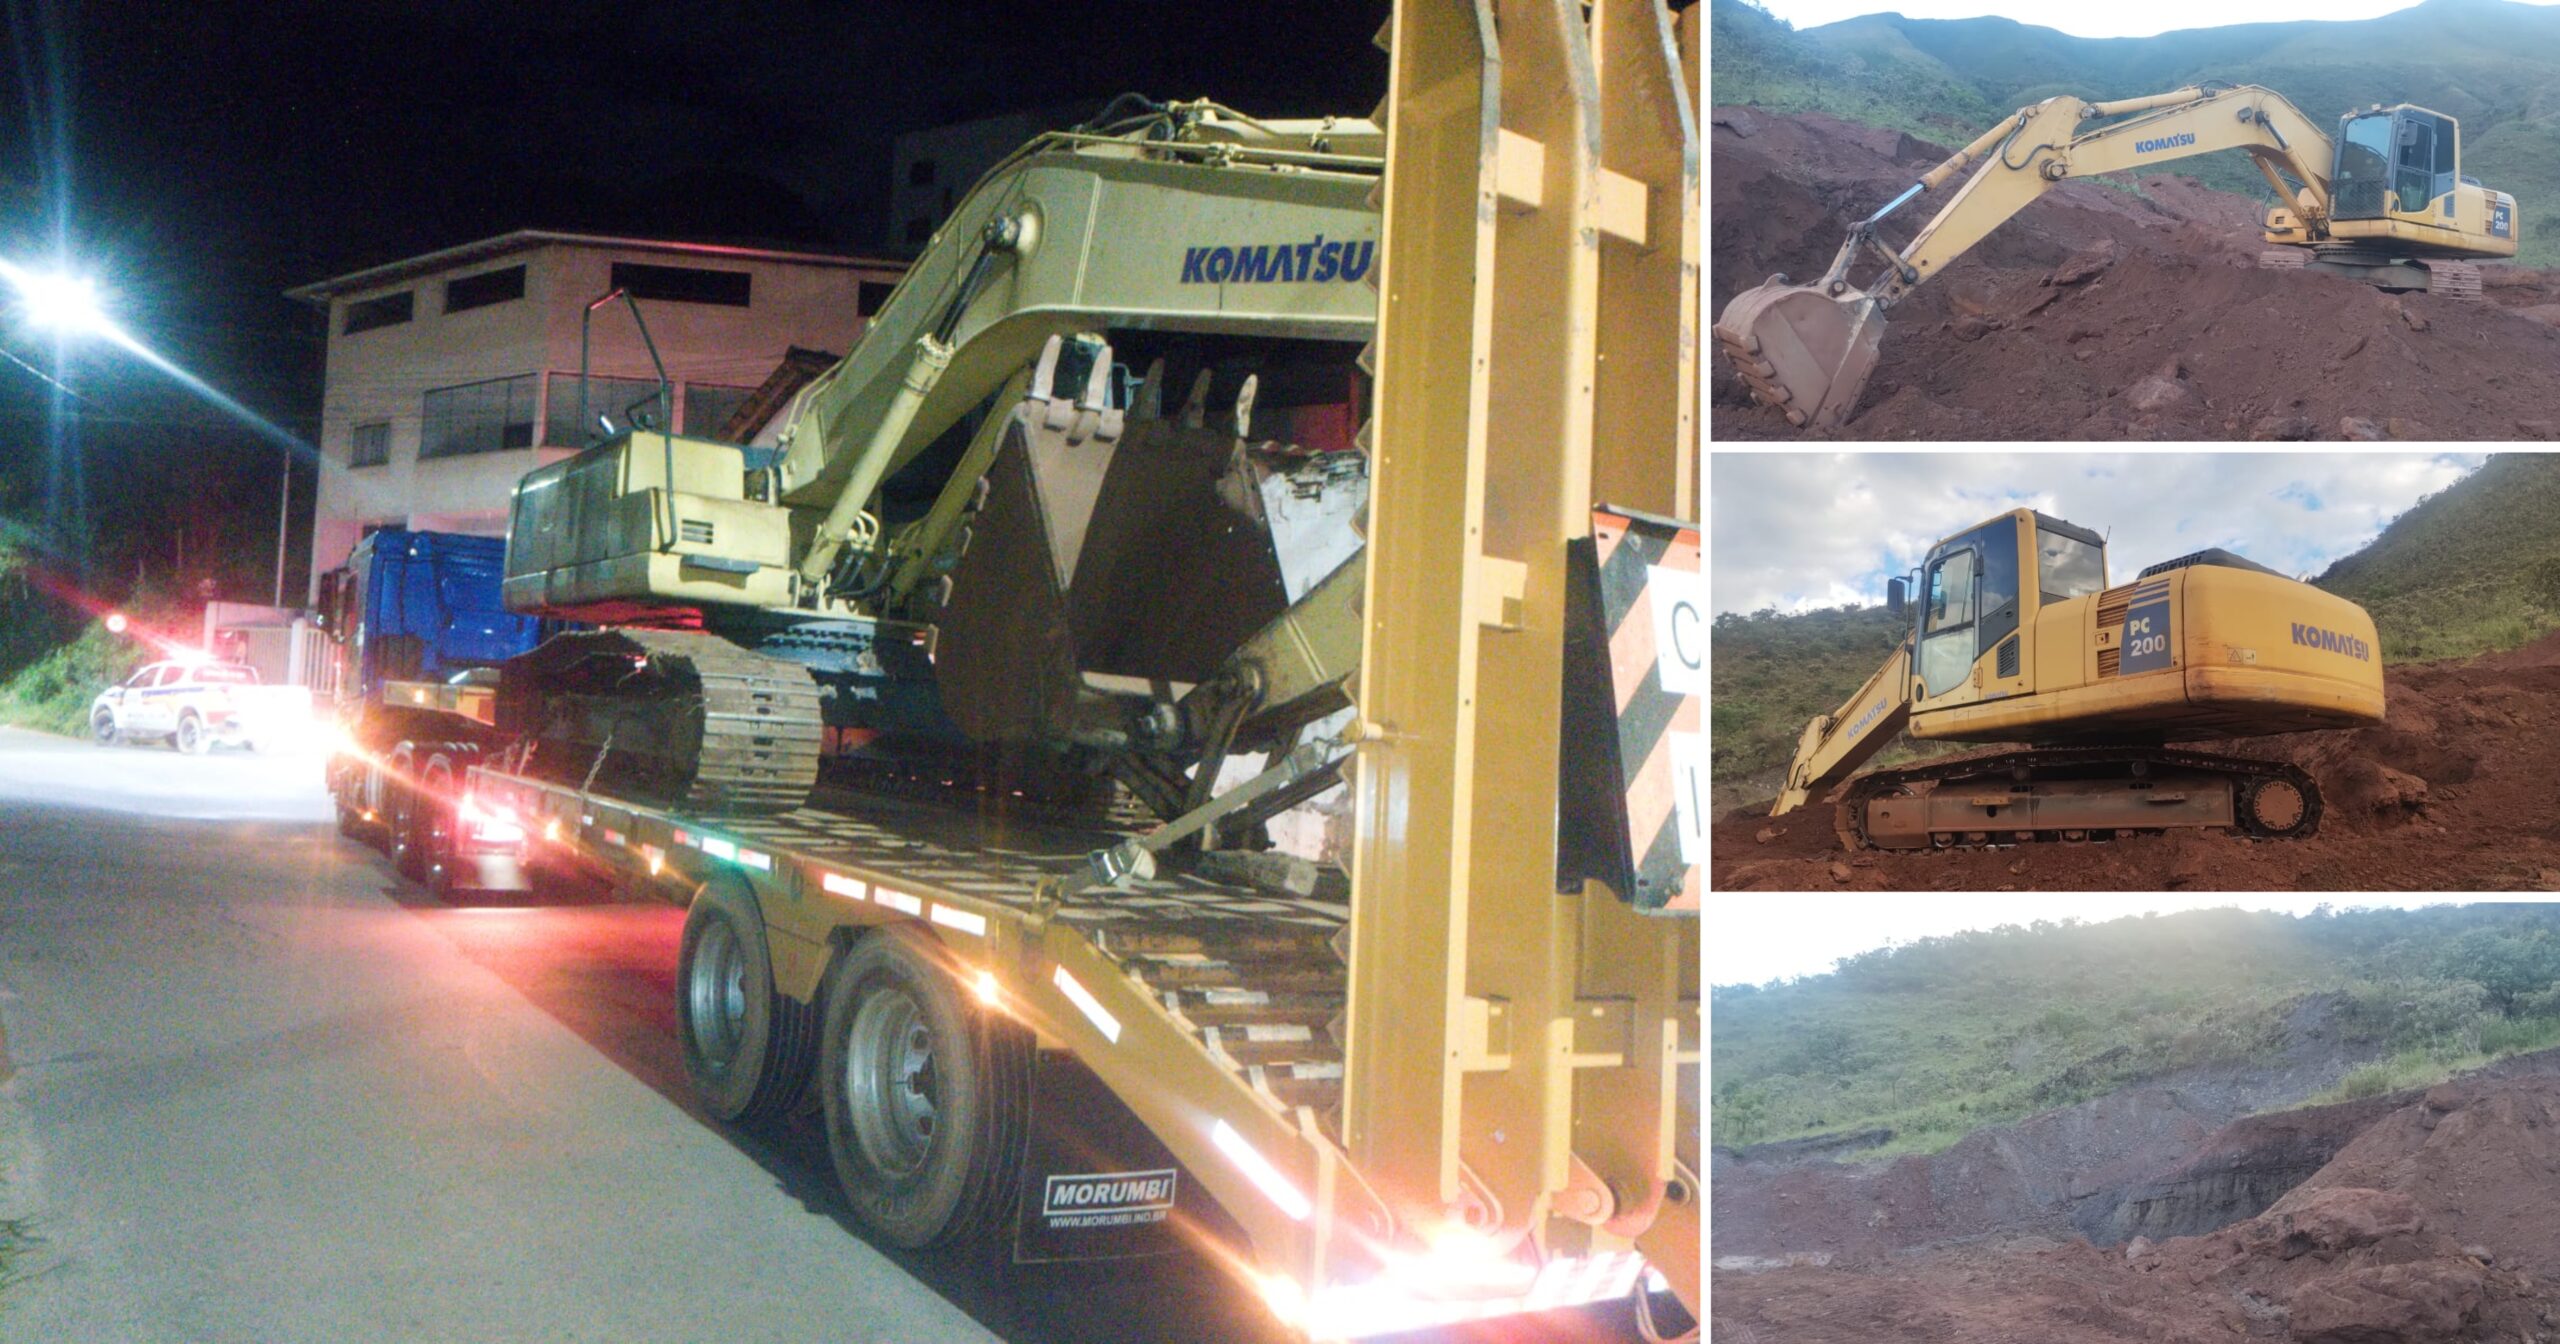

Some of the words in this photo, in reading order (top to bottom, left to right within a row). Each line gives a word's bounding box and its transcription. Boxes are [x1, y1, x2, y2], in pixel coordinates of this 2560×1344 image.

[2135, 132, 2196, 154] KOMATSU
[2495, 211, 2504, 220] PC
[2495, 221, 2509, 231] 200
[1180, 233, 1375, 284] KOMATSU
[2130, 616, 2151, 636] PC
[2130, 634, 2166, 657] 200
[2291, 622, 2370, 662] KOMATSU
[1847, 697, 1888, 741] KOMATSU
[1052, 1178, 1170, 1206] MORUMBI
[1049, 1210, 1168, 1228] WWW.MORUMBI.IND.BR
